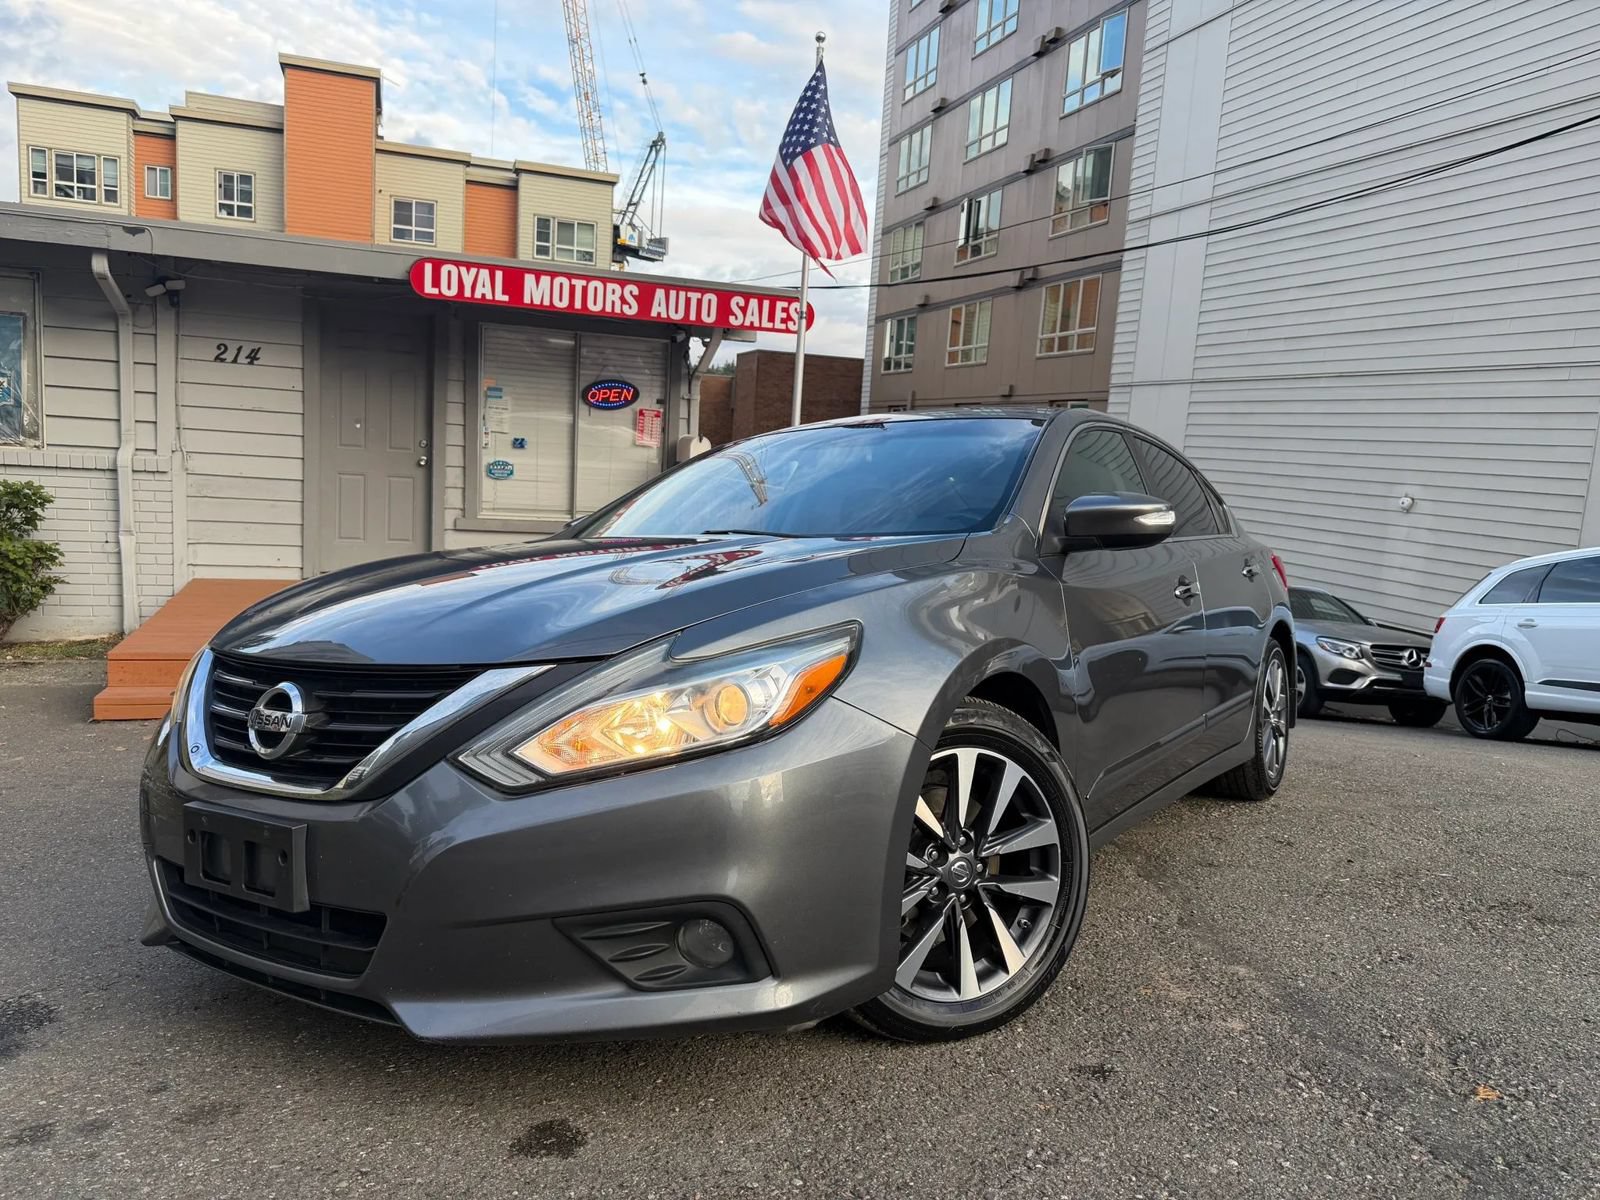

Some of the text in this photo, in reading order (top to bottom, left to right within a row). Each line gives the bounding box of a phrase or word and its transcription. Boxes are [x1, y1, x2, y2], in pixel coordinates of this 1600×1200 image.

[424, 262, 801, 332] LOYAL MOTORS AUTO SALES
[214, 343, 262, 365] 214
[587, 388, 634, 402] OPEN
